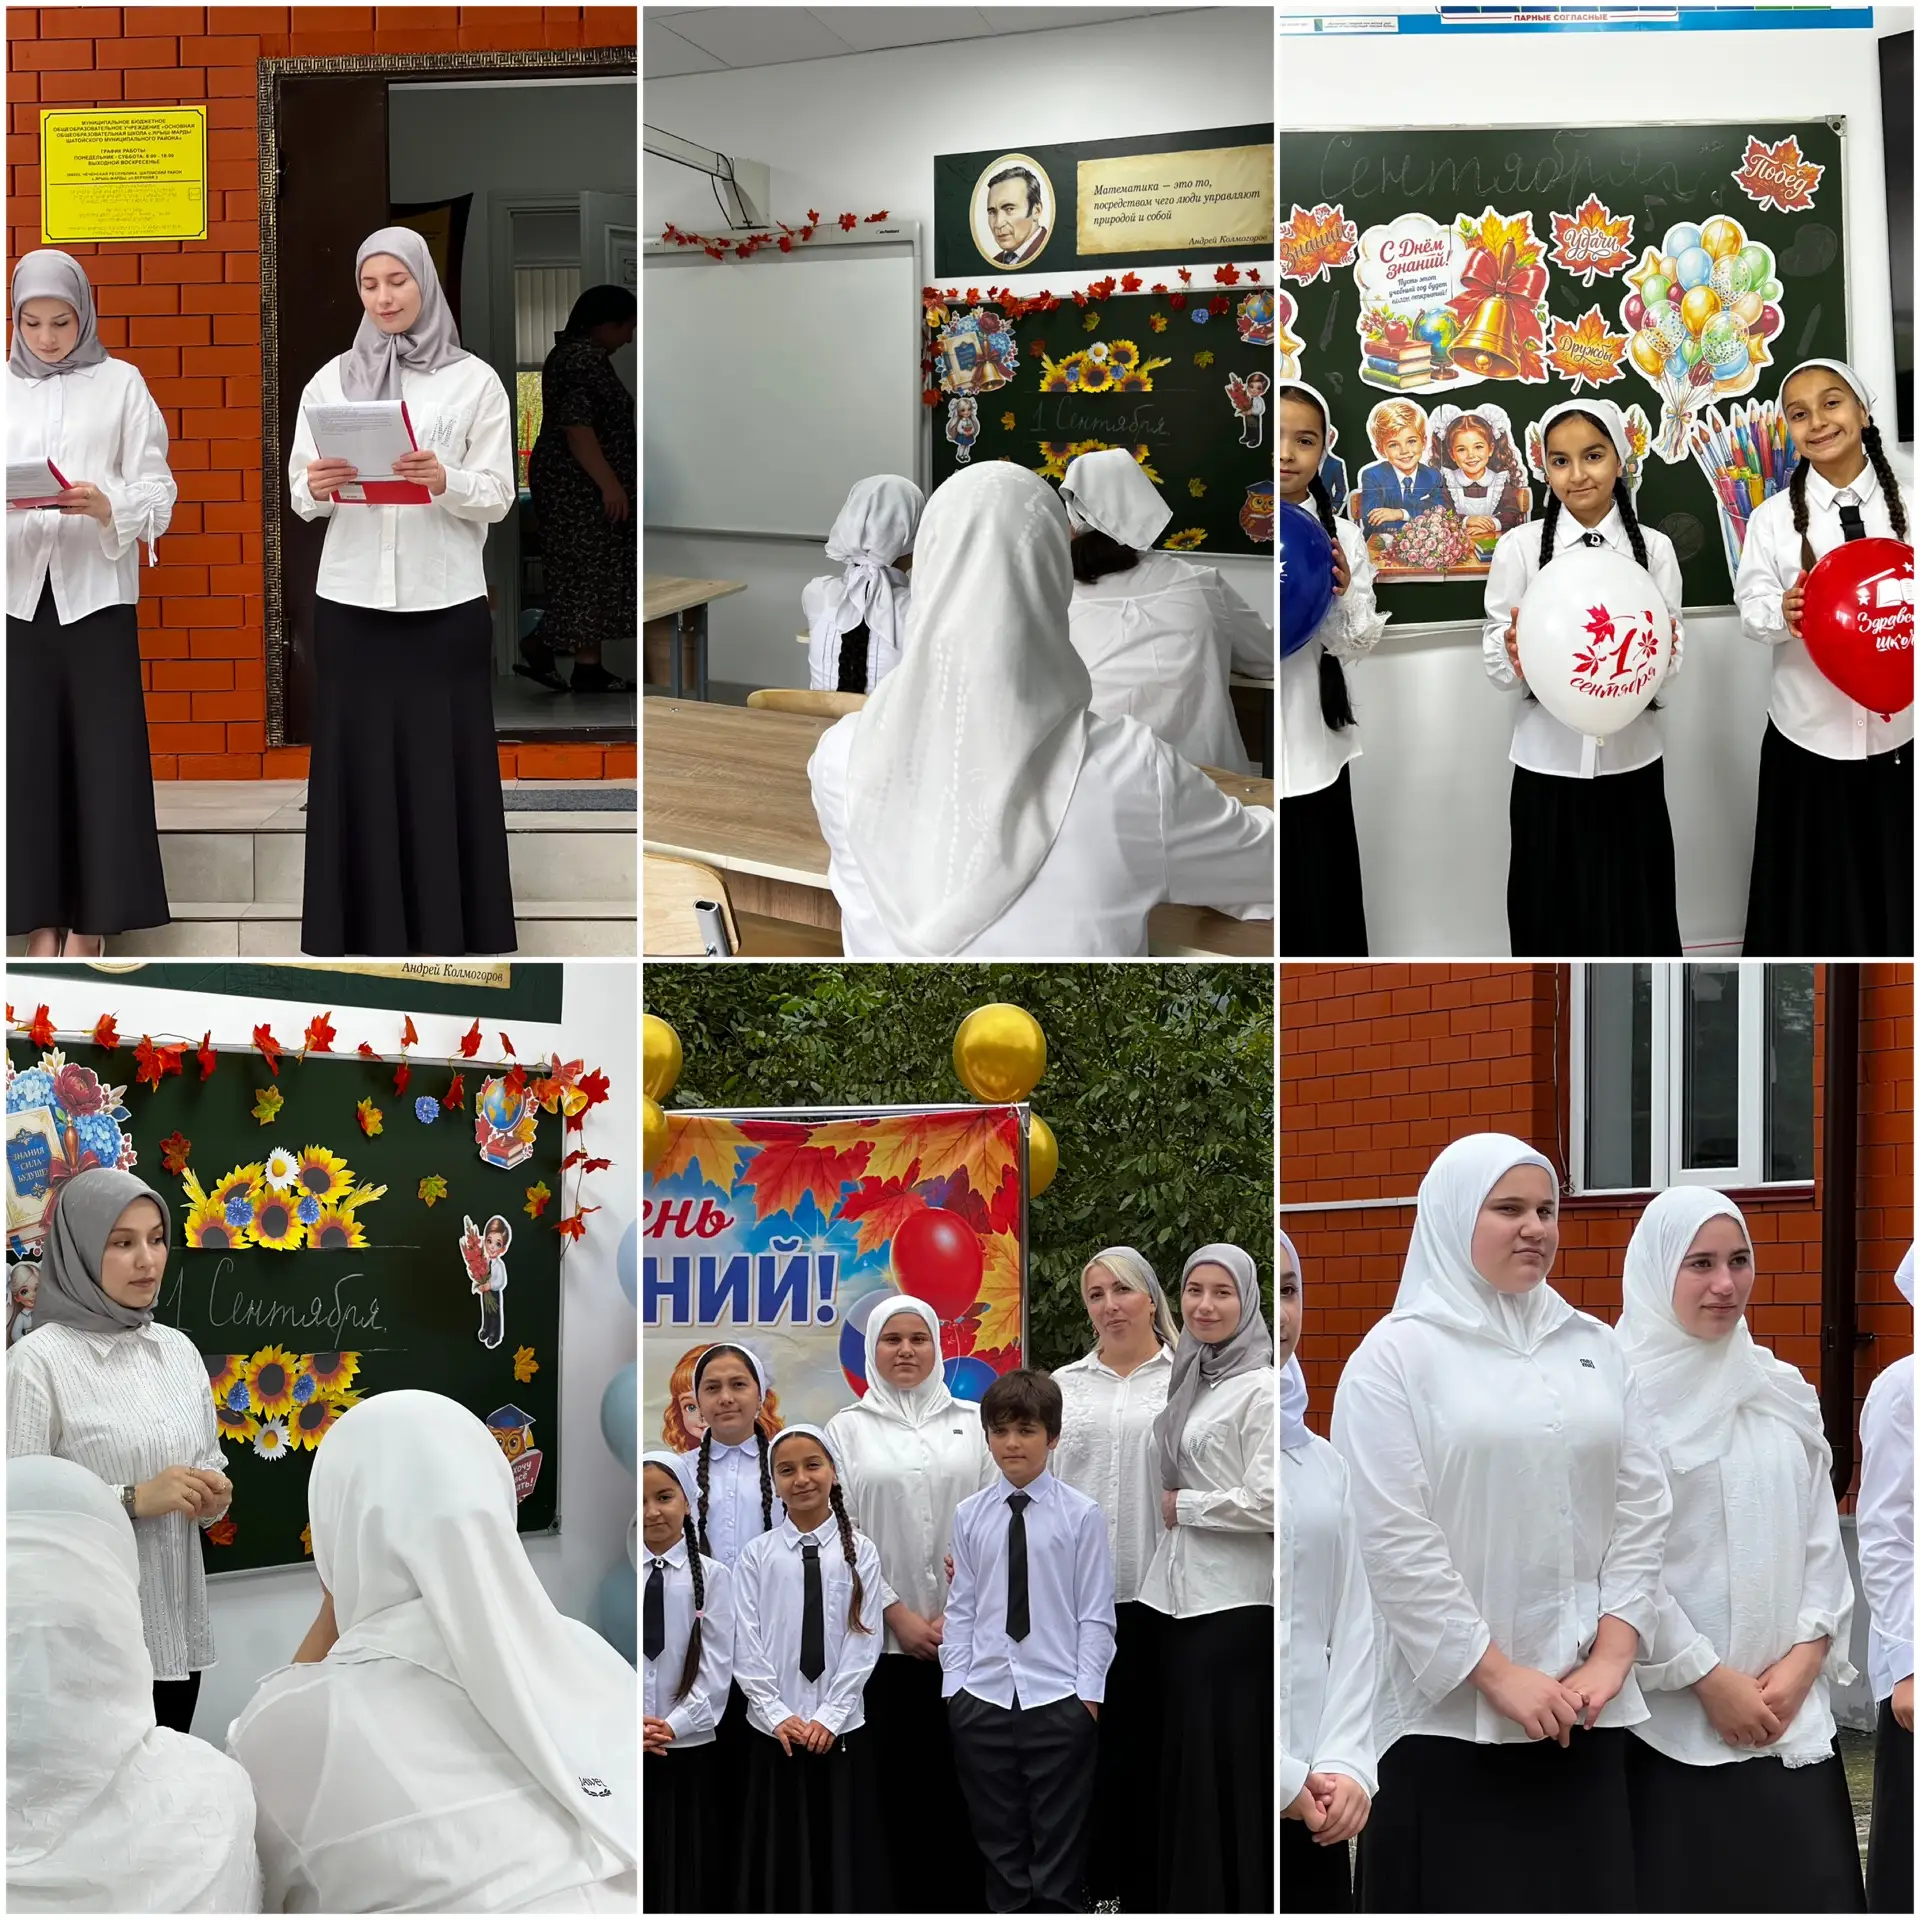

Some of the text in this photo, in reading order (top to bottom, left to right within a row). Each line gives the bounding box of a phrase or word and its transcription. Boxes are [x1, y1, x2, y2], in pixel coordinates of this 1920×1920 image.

[1554, 13, 1608, 21] СОГЛАСНЫЕ
[1093, 182, 1159, 196] Математика
[1173, 180, 1193, 190] это
[1195, 179, 1213, 188] то,
[1744, 154, 1808, 200] Побед
[1093, 190, 1260, 212] посредством чего люди управляют
[1093, 212, 1136, 227] природой
[1146, 210, 1172, 222] собой
[1188, 234, 1268, 246] Андрей Колмогоров
[1280, 222, 1350, 272] Знаний
[1379, 238, 1445, 264] С Днём
[1564, 227, 1619, 261] Удачи
[1385, 249, 1452, 280] знаний!
[1389, 282, 1448, 298] учебный год будет
[1398, 275, 1437, 287] Пусть этот
[1411, 288, 1448, 301] открытий!
[1559, 335, 1613, 366] Дружбы
[1030, 400, 1047, 432] 1
[1857, 606, 1914, 634] Здравс
[1608, 627, 1637, 680] 1
[1570, 661, 1656, 698] сентября
[401, 963, 503, 984] Андрей Колмогоров
[13, 1146, 45, 1161] ЗНАНИЯ
[643, 1238, 837, 1324] НИЙ!
[166, 1267, 193, 1333] 1
